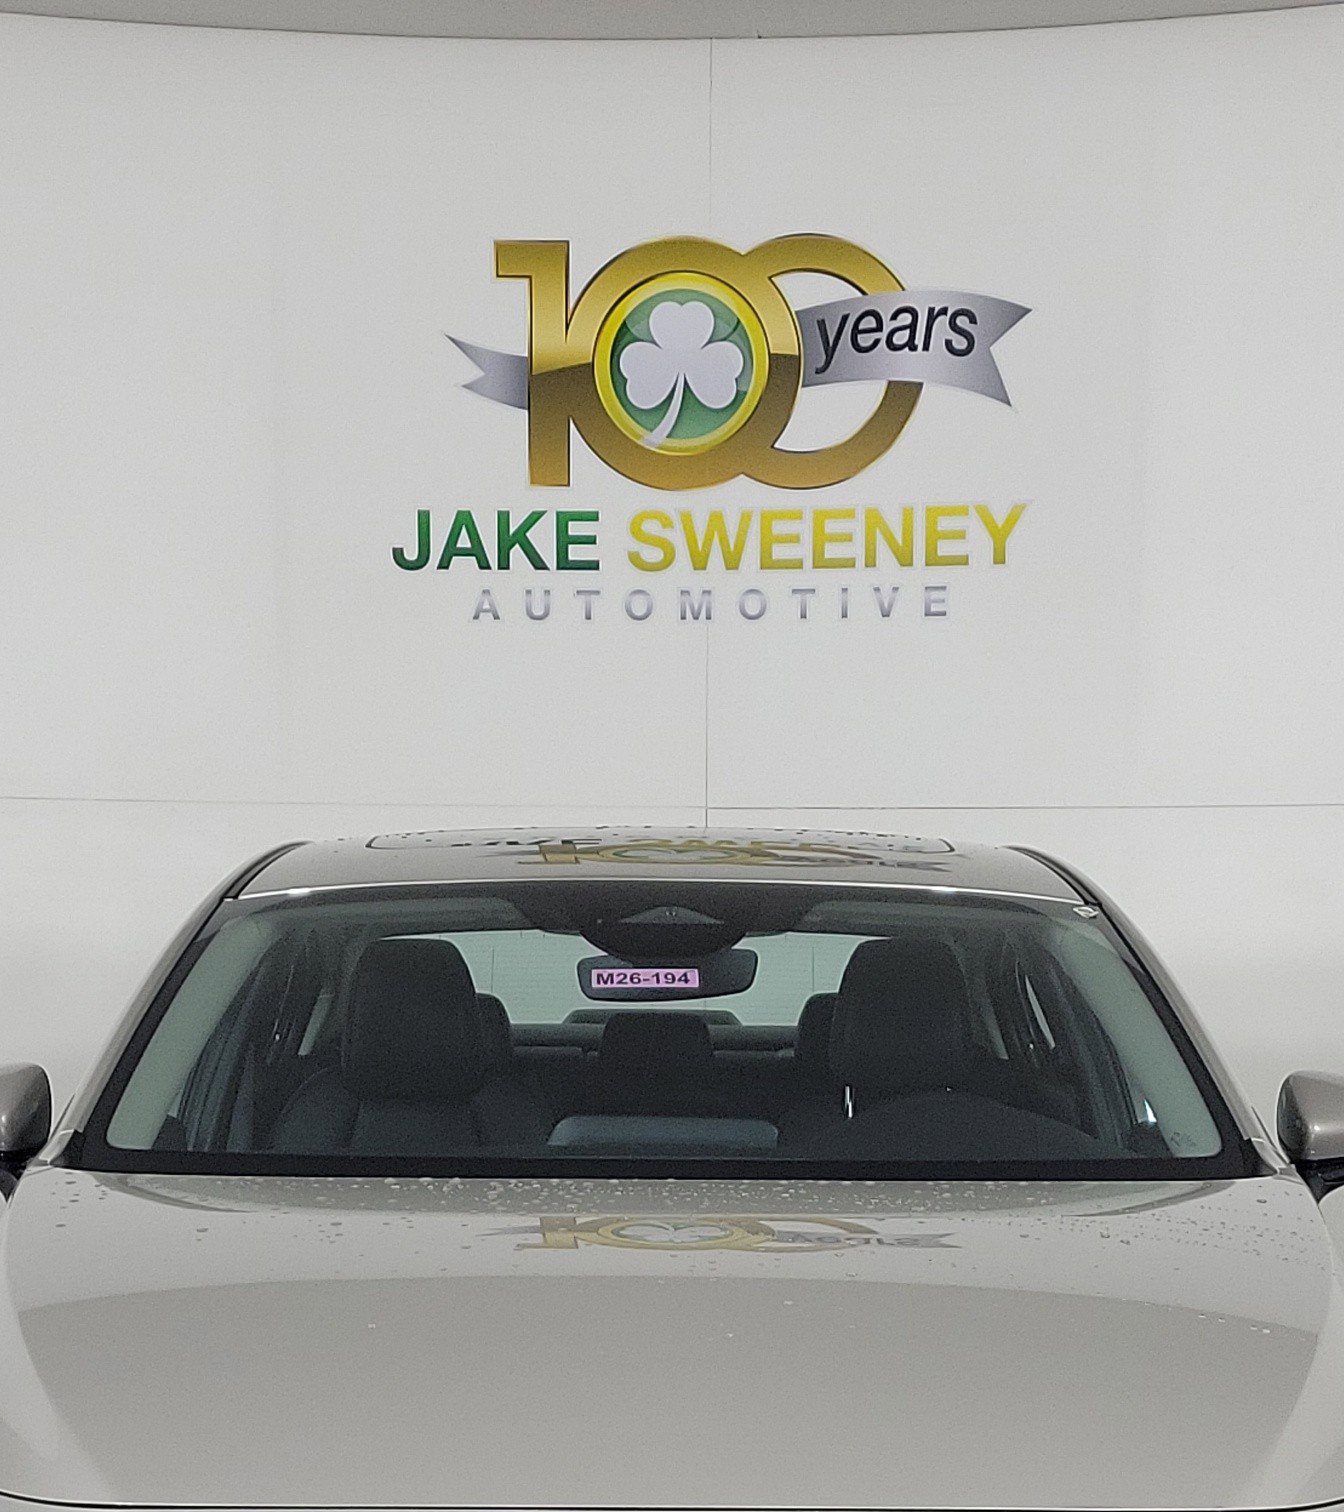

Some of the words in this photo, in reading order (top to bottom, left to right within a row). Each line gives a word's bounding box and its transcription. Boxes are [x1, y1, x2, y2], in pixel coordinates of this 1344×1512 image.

[814, 303, 978, 374] years
[391, 509, 601, 573] JAKE
[626, 504, 1027, 573] SWEENEY
[472, 586, 948, 621] AUTOMOTIVE
[596, 972, 691, 985] M26-194
